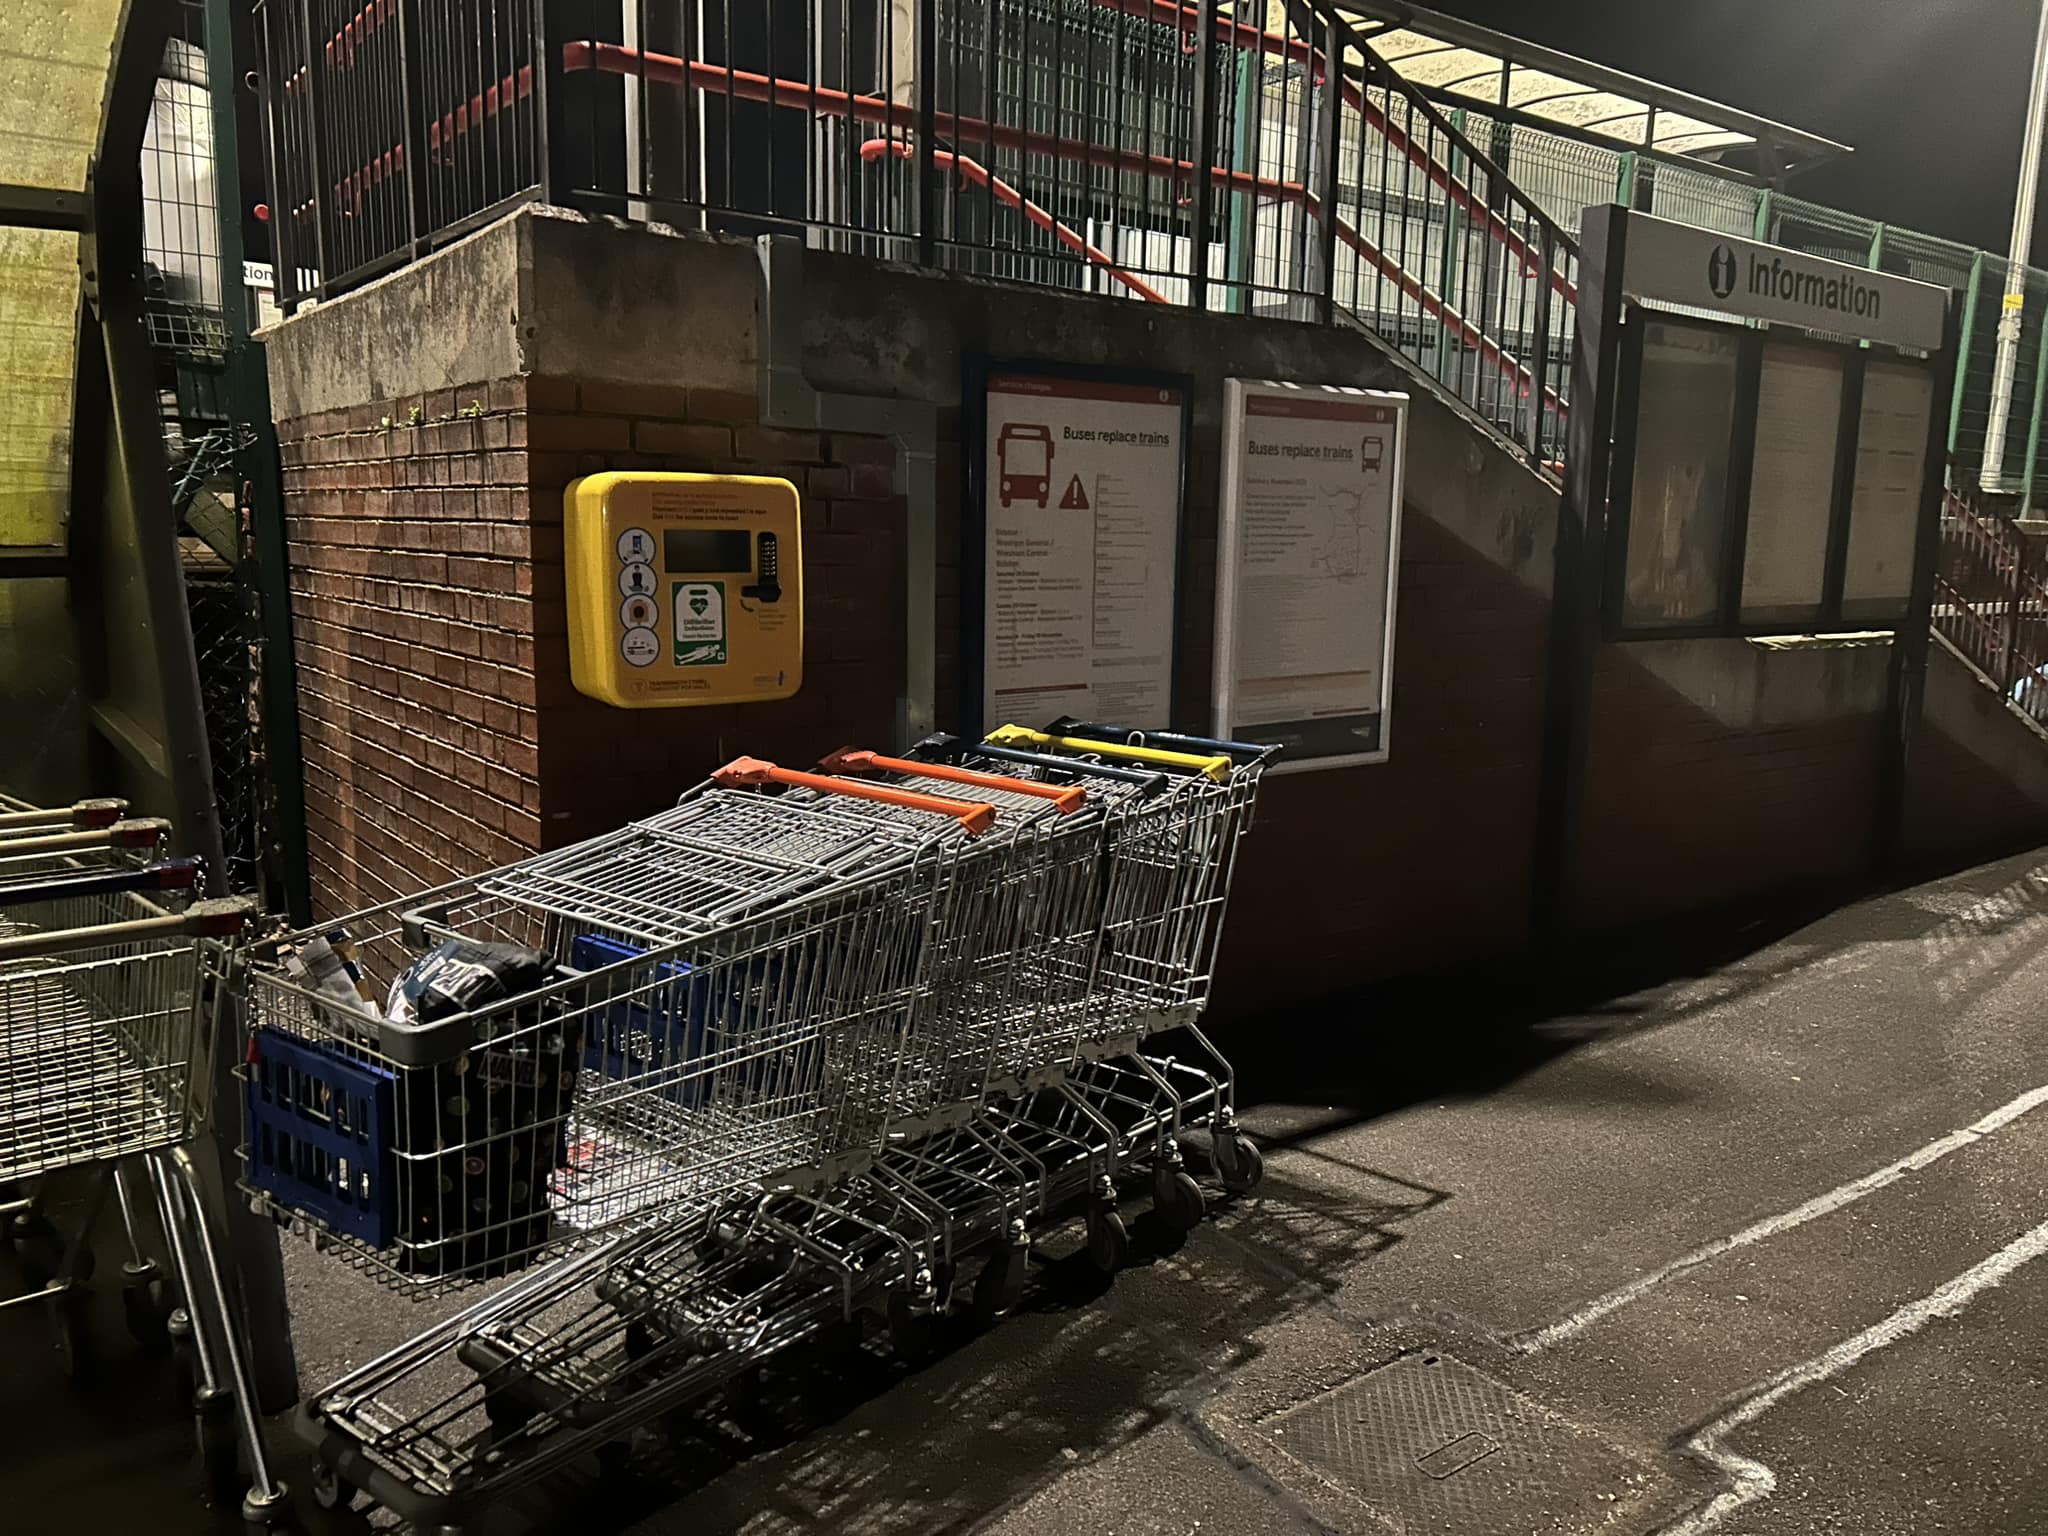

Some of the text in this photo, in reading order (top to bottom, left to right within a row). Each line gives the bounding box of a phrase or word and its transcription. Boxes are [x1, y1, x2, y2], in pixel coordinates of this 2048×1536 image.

[1748, 252, 1881, 319] Information
[1063, 426, 1170, 445] Buses replace trains
[1248, 441, 1354, 459] Buses replace trains
